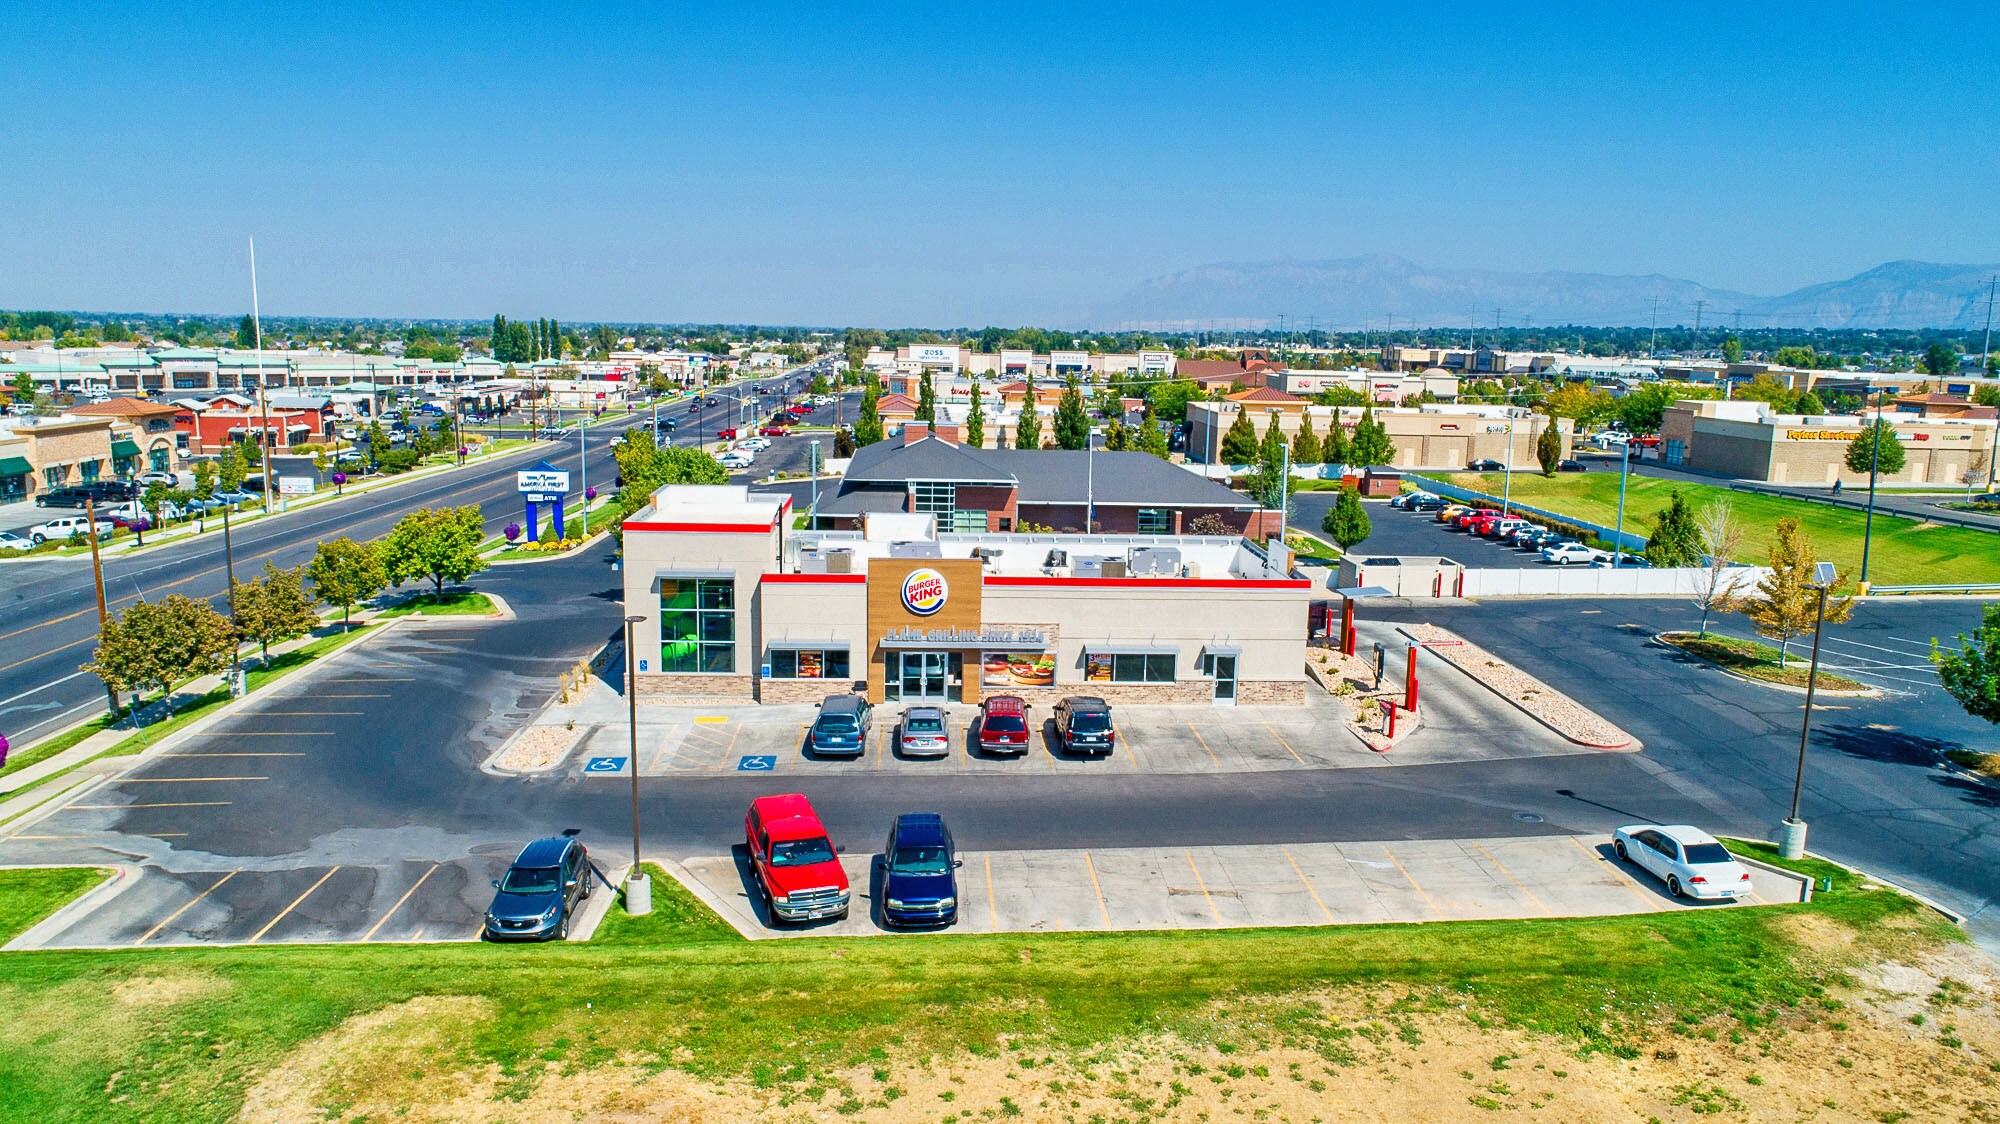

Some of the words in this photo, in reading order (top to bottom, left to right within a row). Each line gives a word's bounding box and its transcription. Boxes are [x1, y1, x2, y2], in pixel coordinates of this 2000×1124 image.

[1787, 430, 1818, 441] Payless
[1820, 431, 1861, 441] ShoeSour
[908, 578, 941, 593] BURGER
[909, 585, 943, 604] KING
[887, 628, 923, 641] FLAME
[927, 629, 978, 642] GRILLING
